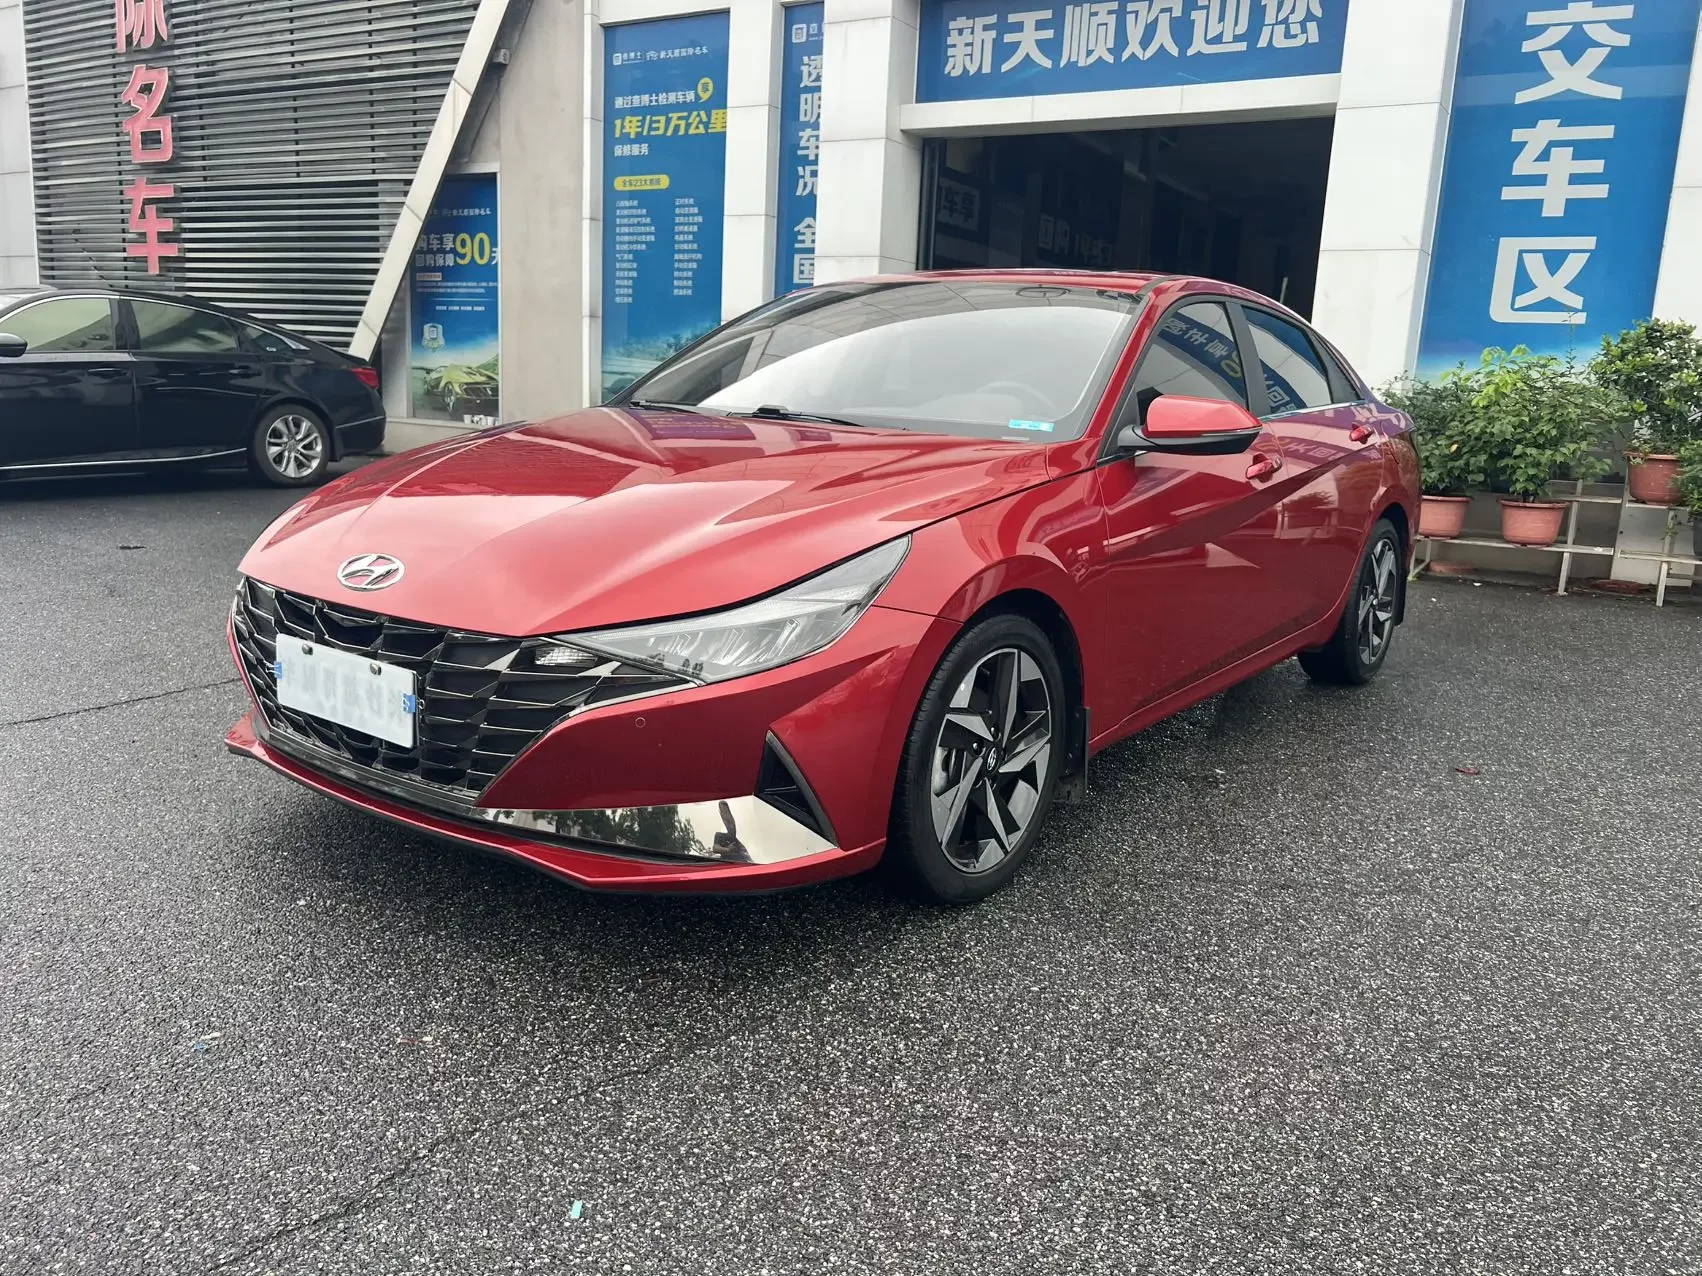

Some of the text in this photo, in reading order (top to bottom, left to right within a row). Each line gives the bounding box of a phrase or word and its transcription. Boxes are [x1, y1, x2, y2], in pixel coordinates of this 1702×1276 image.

[943, 0, 1324, 78] 新天顺欢迎您
[613, 143, 650, 157] 保修服务
[614, 108, 728, 139] 1年/3万公里
[1489, 0, 1635, 325] 交车区
